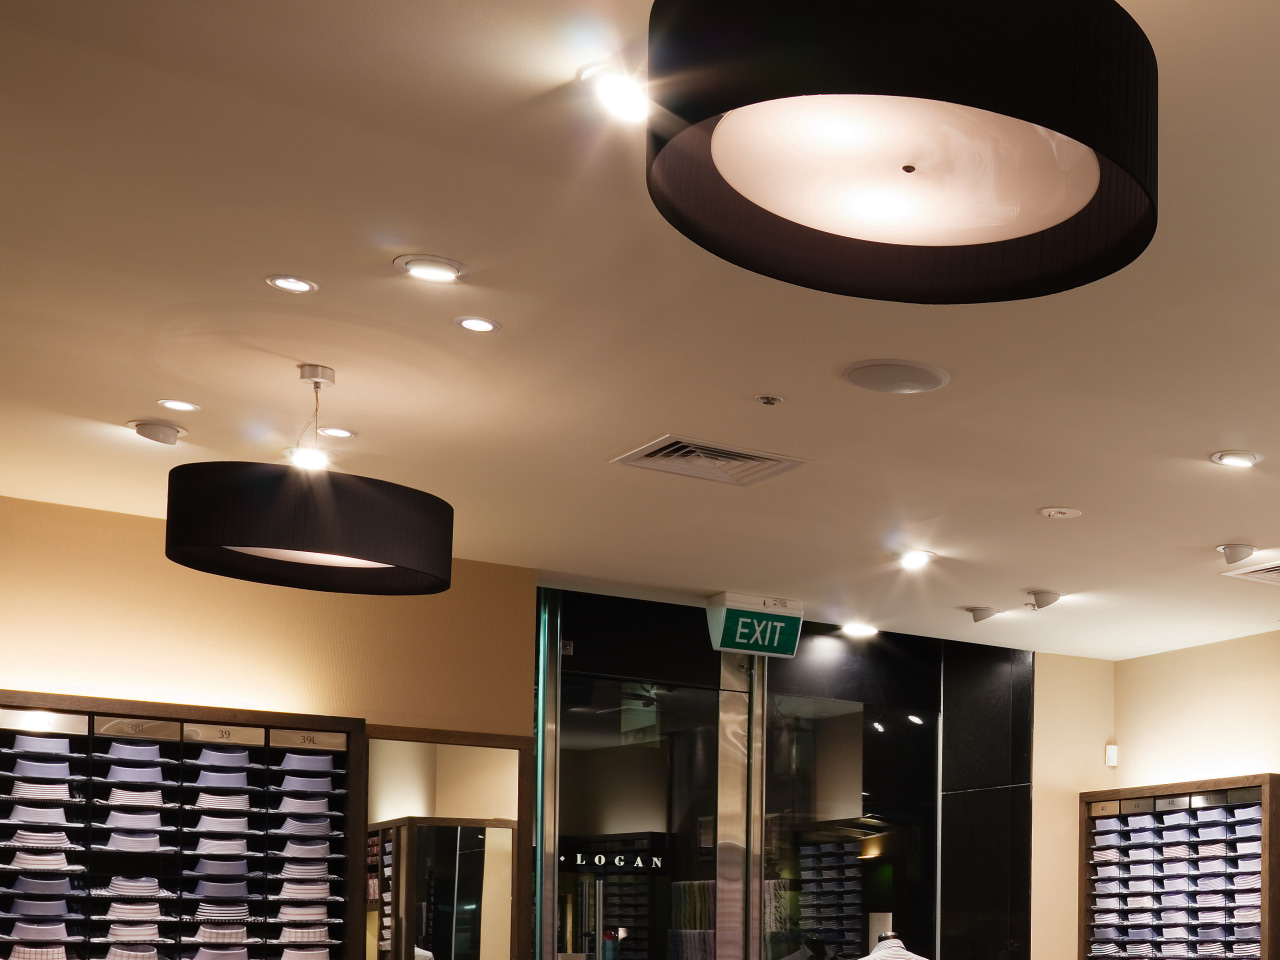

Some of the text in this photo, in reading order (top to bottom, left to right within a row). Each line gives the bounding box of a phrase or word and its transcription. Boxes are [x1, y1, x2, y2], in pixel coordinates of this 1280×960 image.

[735, 617, 786, 647] EXIT
[218, 729, 231, 739] 39
[300, 735, 317, 745] 39L
[576, 853, 662, 868] LOGAN
